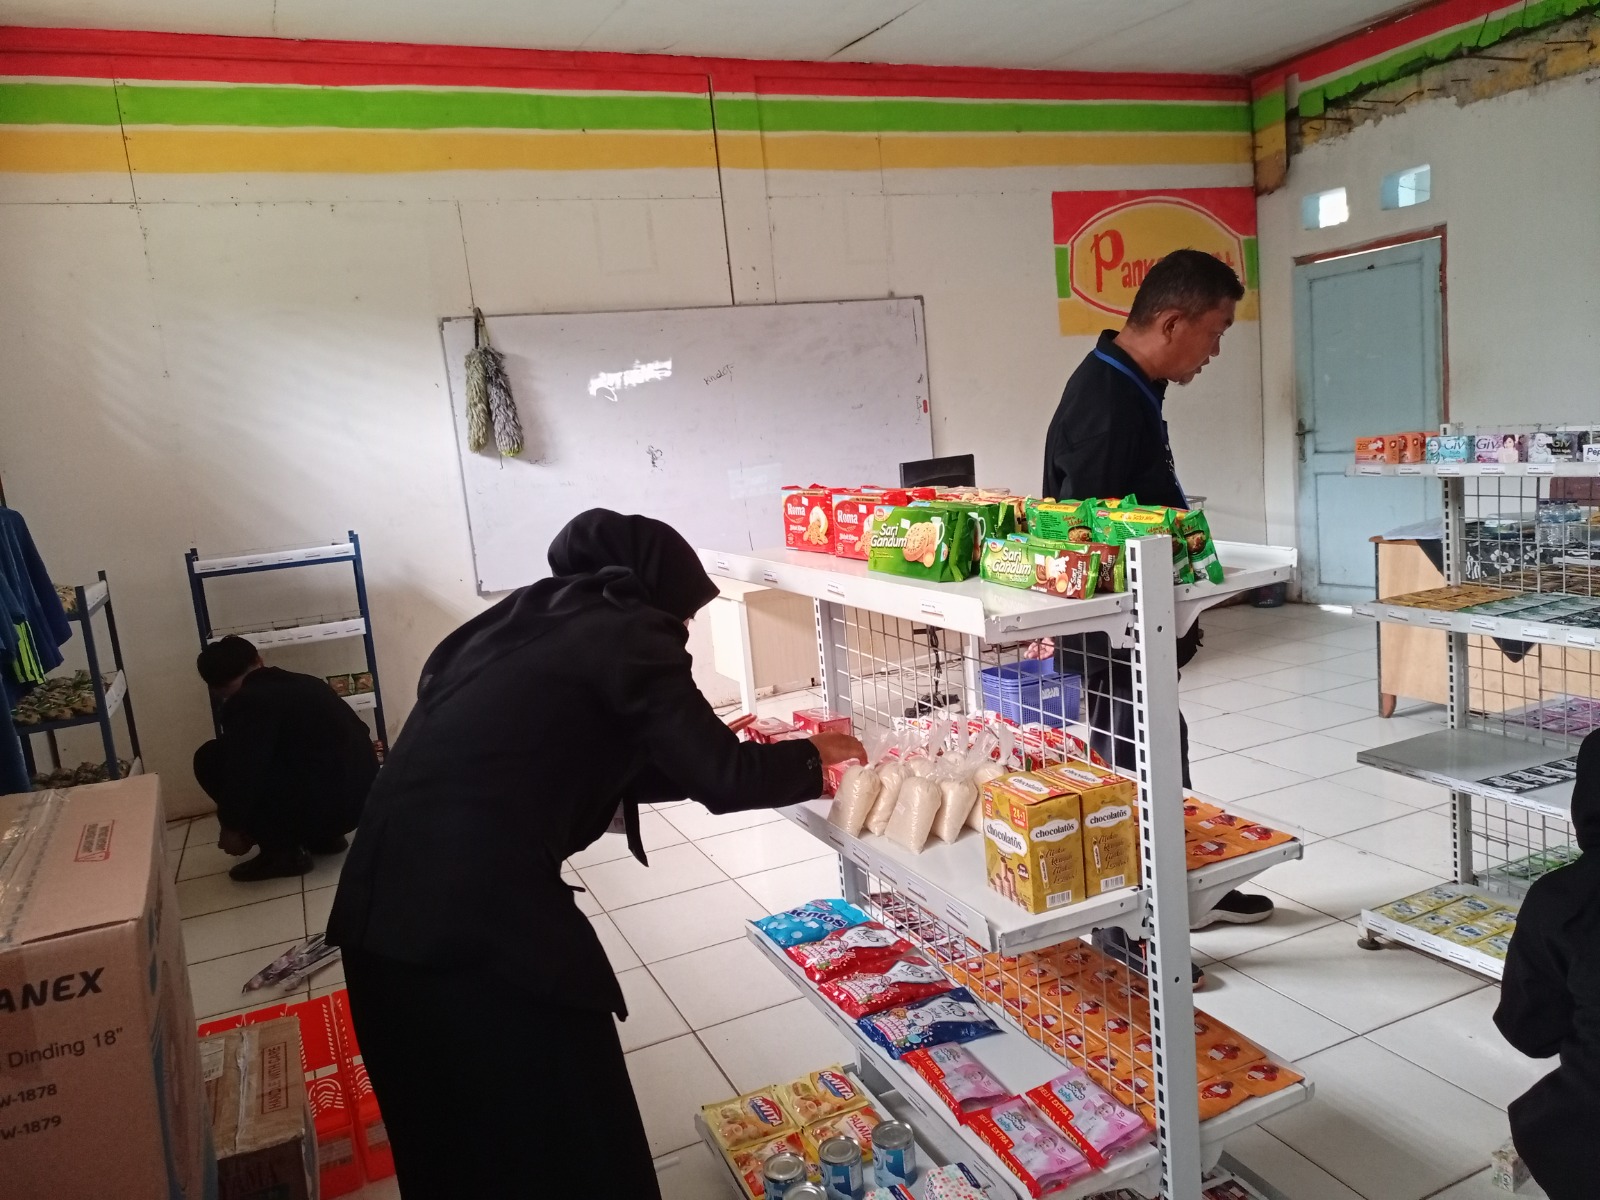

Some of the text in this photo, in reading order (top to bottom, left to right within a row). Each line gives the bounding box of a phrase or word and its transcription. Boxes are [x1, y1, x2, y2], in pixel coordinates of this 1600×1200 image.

[1476, 438, 1499, 450] Giv
[787, 503, 806, 516] Roma
[837, 510, 859, 525] Roma
[879, 523, 900, 538] Sari
[870, 535, 908, 549] Gandum
[1002, 546, 1022, 563] Sari
[992, 560, 1032, 577] Gandum
[0, 967, 105, 1014] ANEX
[8, 1027, 124, 1068] Dinding 18"
[818, 1070, 857, 1101] forVITA
[268, 1079, 281, 1110] HANDE
[1057, 1087, 1073, 1102] baby
[750, 1095, 785, 1127] forVITA
[1051, 1099, 1070, 1117] EXTRA
[1, 1115, 62, 1140] W-1879
[849, 1112, 873, 1144] PALMIA
[997, 1117, 1012, 1132] baby
[992, 1127, 1010, 1145] EXTRA
[774, 1140, 789, 1155] PAL
